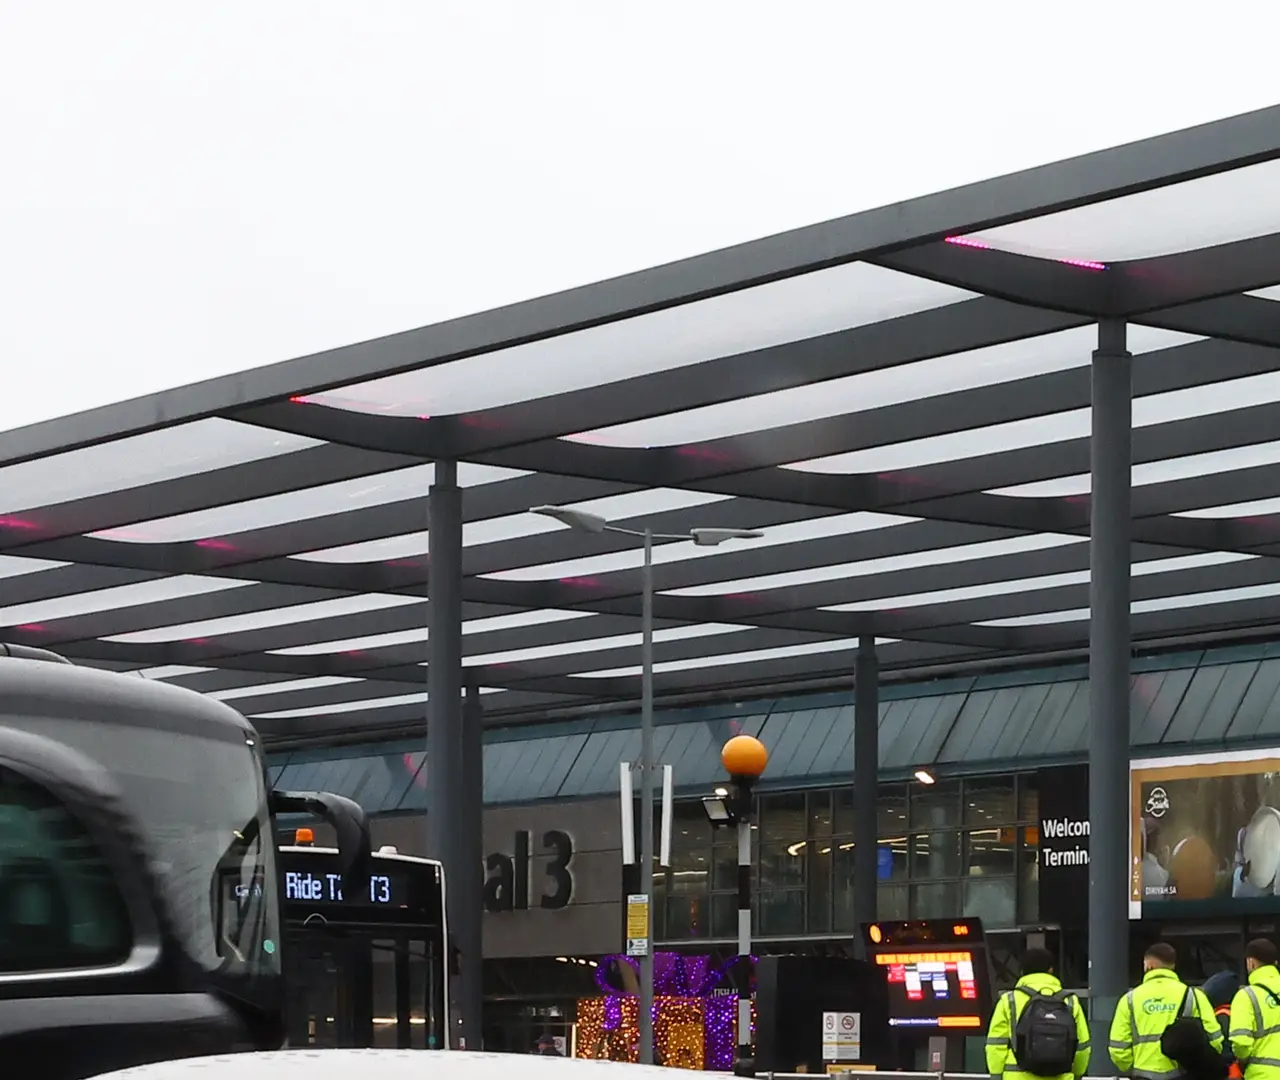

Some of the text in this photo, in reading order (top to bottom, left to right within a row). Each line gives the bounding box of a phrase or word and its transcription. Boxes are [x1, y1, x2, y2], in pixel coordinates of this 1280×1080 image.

[541, 829, 573, 910] 3
[1042, 845, 1090, 867] Termin
[285, 872, 322, 900] Ride
